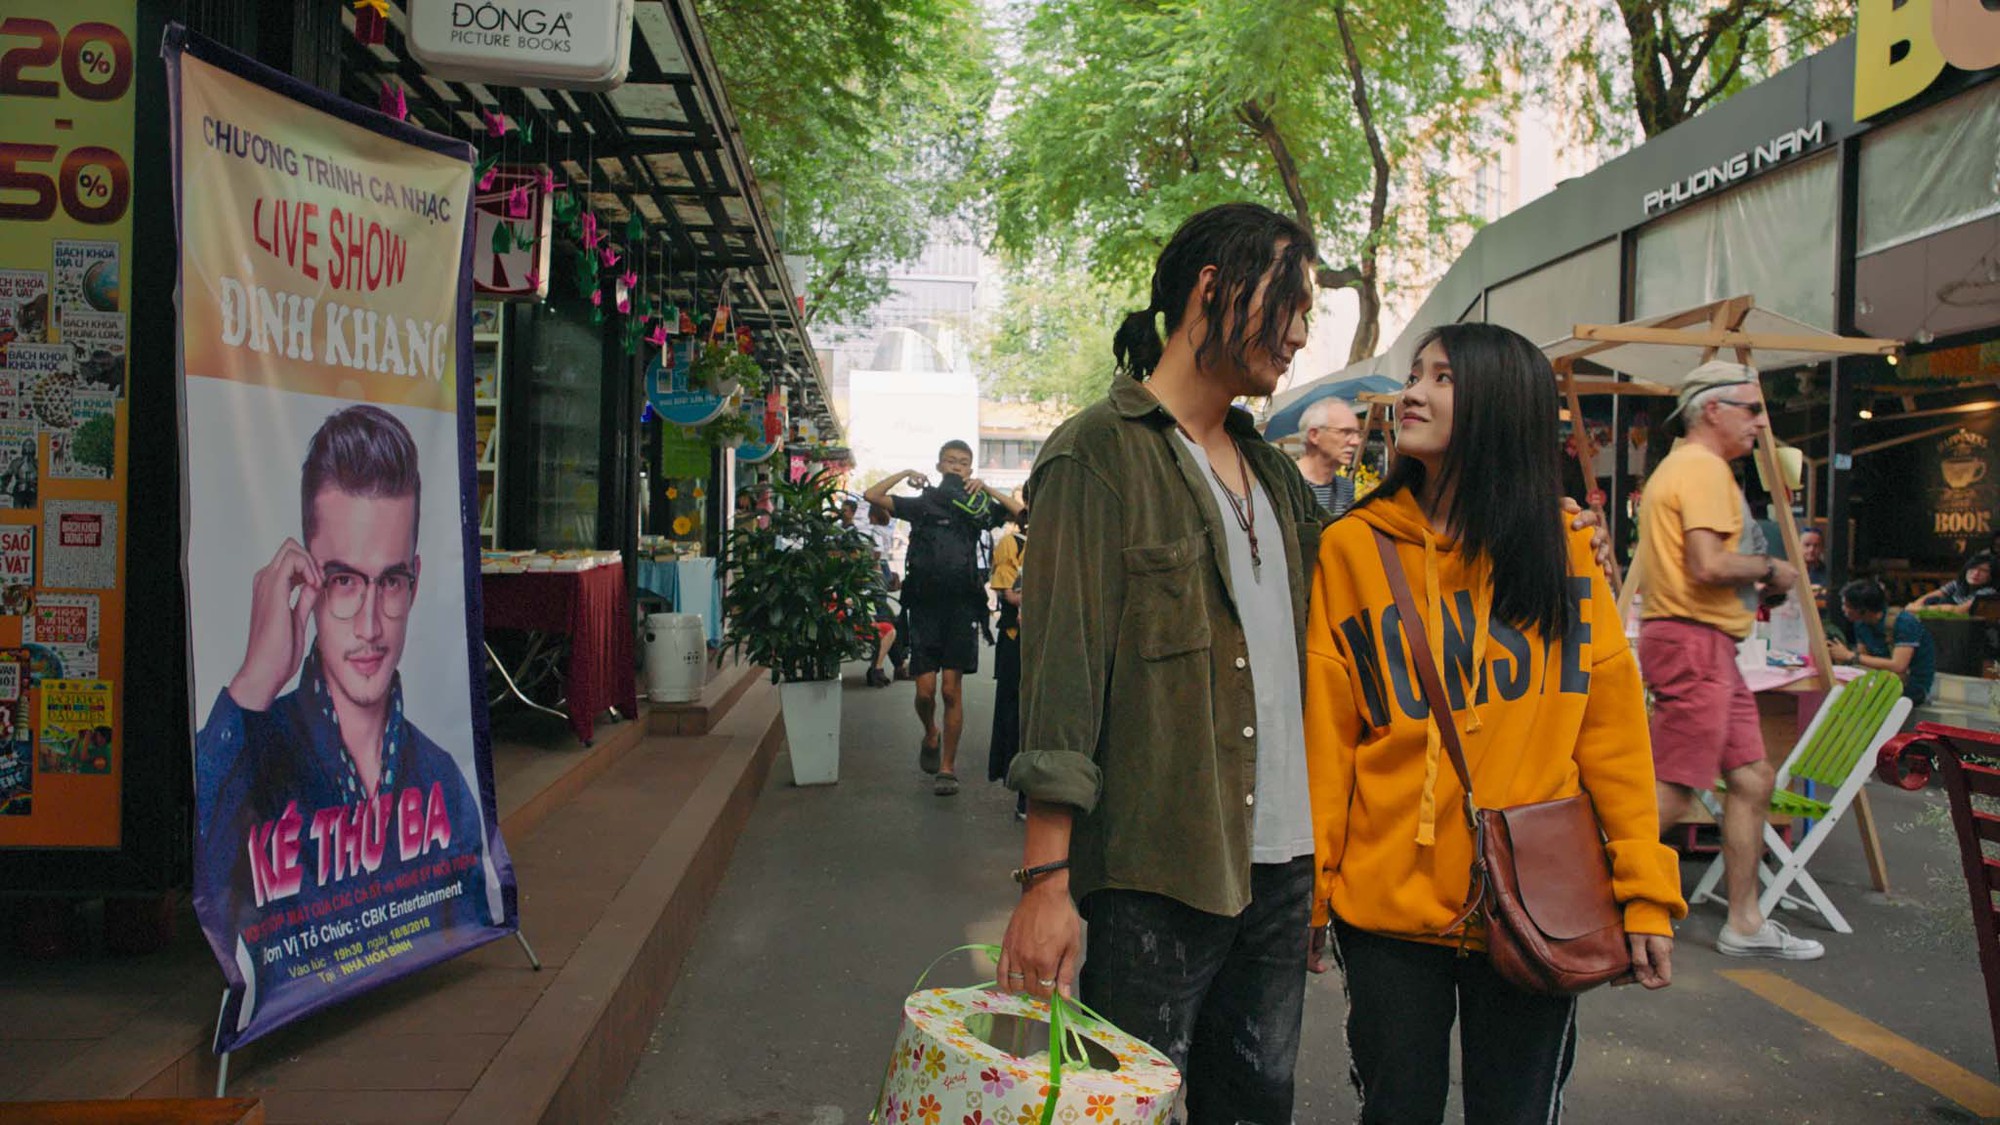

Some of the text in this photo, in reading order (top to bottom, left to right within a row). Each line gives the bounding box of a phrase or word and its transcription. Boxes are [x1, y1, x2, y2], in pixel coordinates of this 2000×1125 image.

[451, 30, 571, 53] PICTURE BOOKS
[203, 115, 450, 225] CHƯƠNG TRÌNH CA NHẠC
[1643, 120, 1824, 215] PHUONG NAM
[254, 197, 406, 291] LIVE SHOW
[326, 302, 448, 381] KHANG
[1934, 509, 1992, 533] BOOK
[398, 781, 451, 862] BA
[361, 904, 388, 928] CBK
[390, 881, 463, 919] Entertainment
[333, 942, 364, 962] 19h30
